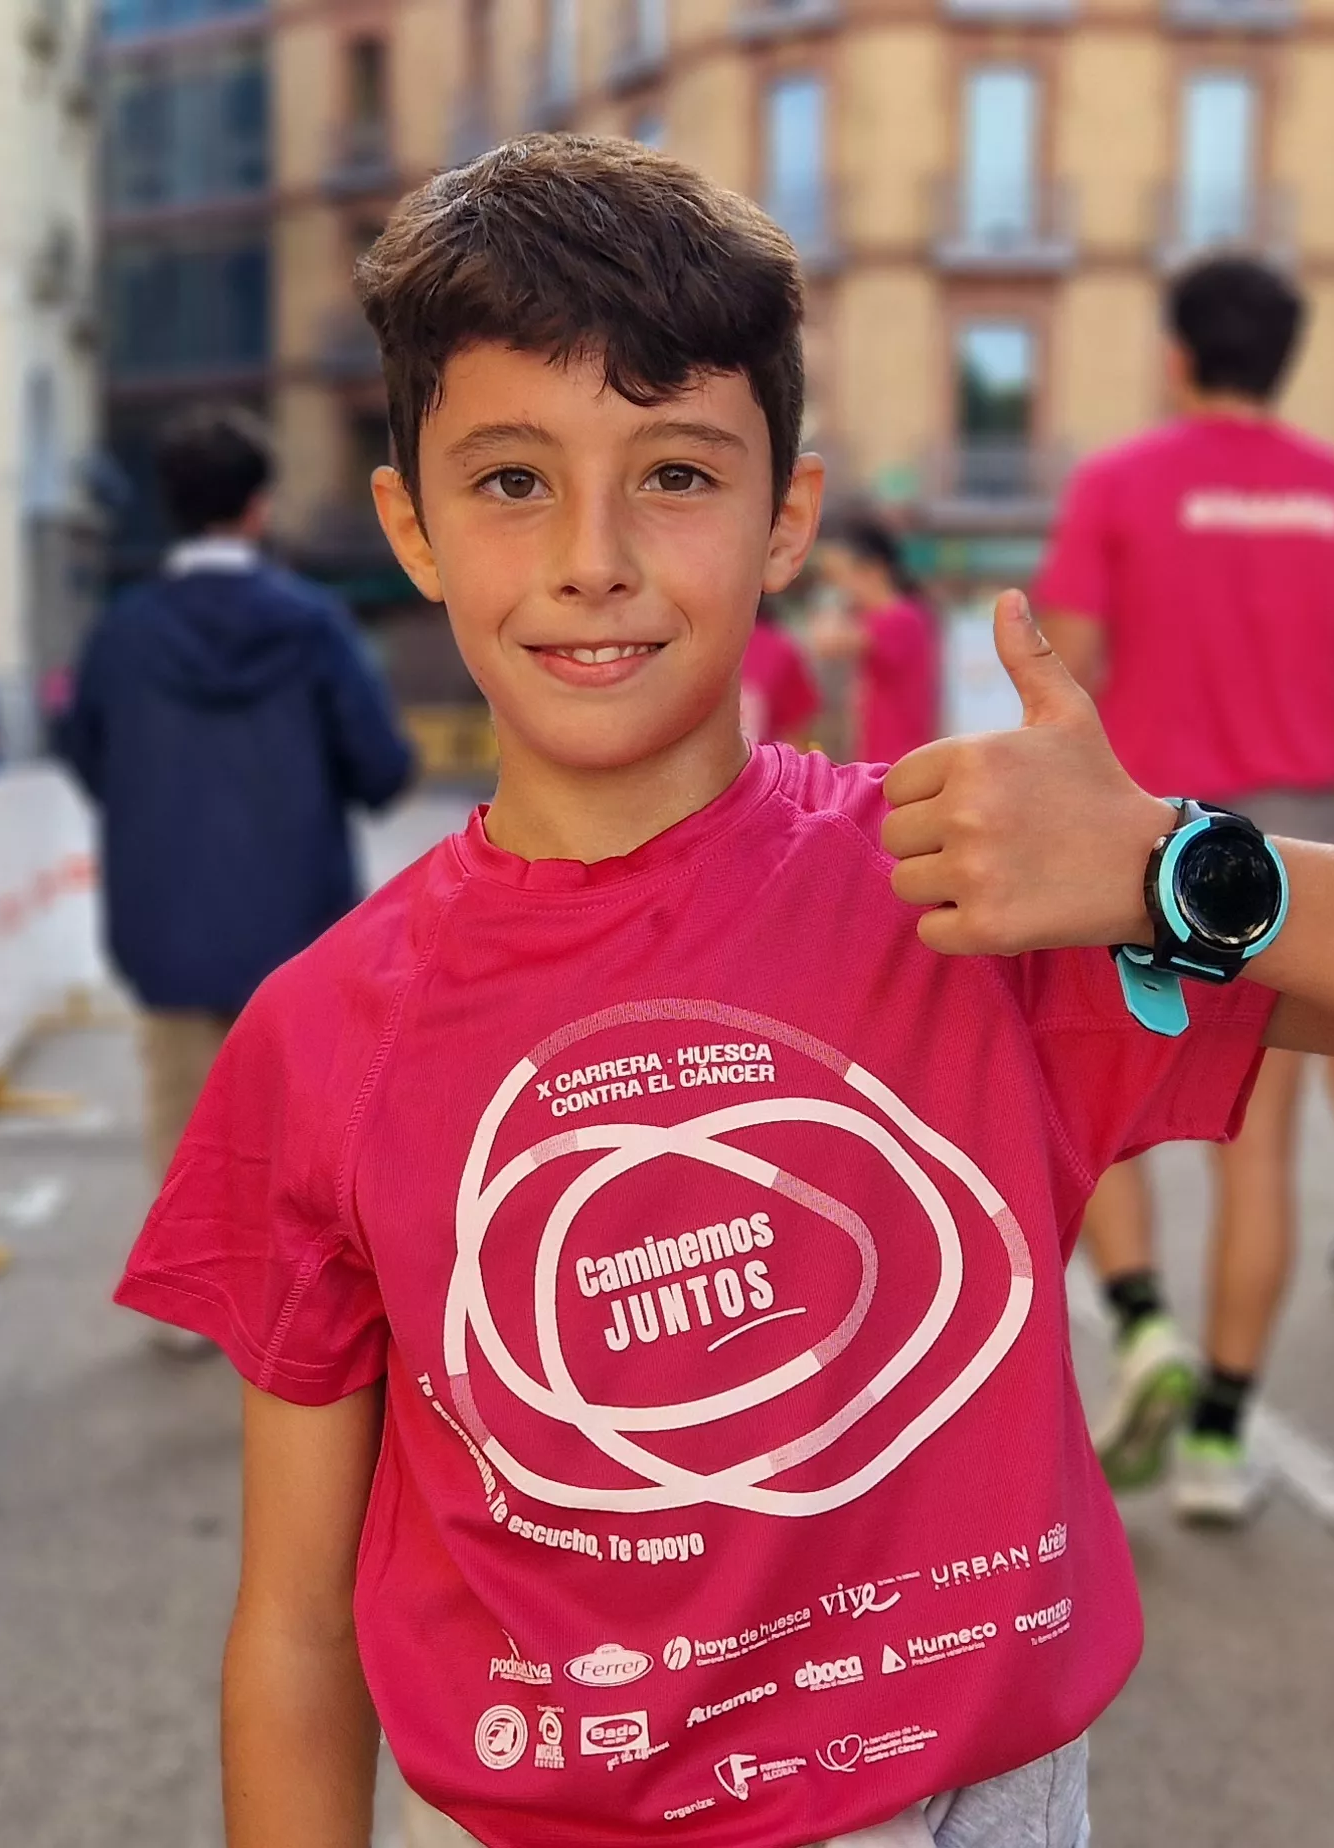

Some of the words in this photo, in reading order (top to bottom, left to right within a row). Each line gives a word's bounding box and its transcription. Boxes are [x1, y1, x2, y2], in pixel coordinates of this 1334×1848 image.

[535, 1079, 553, 1101] X
[555, 1053, 663, 1094] CARRERA
[677, 1042, 773, 1065] HUESCA
[551, 1080, 644, 1117] CONTRA
[648, 1074, 675, 1094] EL
[680, 1060, 776, 1088] CÁNCER
[575, 1211, 775, 1298] Caminemos
[603, 1259, 775, 1352] JUNTOS
[488, 1490, 509, 1524] Te
[507, 1514, 604, 1561] escucho,
[608, 1534, 633, 1562] Te
[636, 1532, 705, 1565] apoyo
[930, 1544, 1030, 1584] URBAN
[819, 1582, 902, 1620] vive
[694, 1637, 738, 1658] hoya
[739, 1629, 758, 1647] de
[759, 1607, 811, 1638] huesca
[907, 1621, 998, 1658] Humeco
[579, 1659, 644, 1678] Ferrer
[794, 1655, 865, 1689] eboca
[686, 1681, 779, 1729] Alcampo
[590, 1723, 641, 1741] Bada
[664, 1797, 716, 1821] Organiza:
